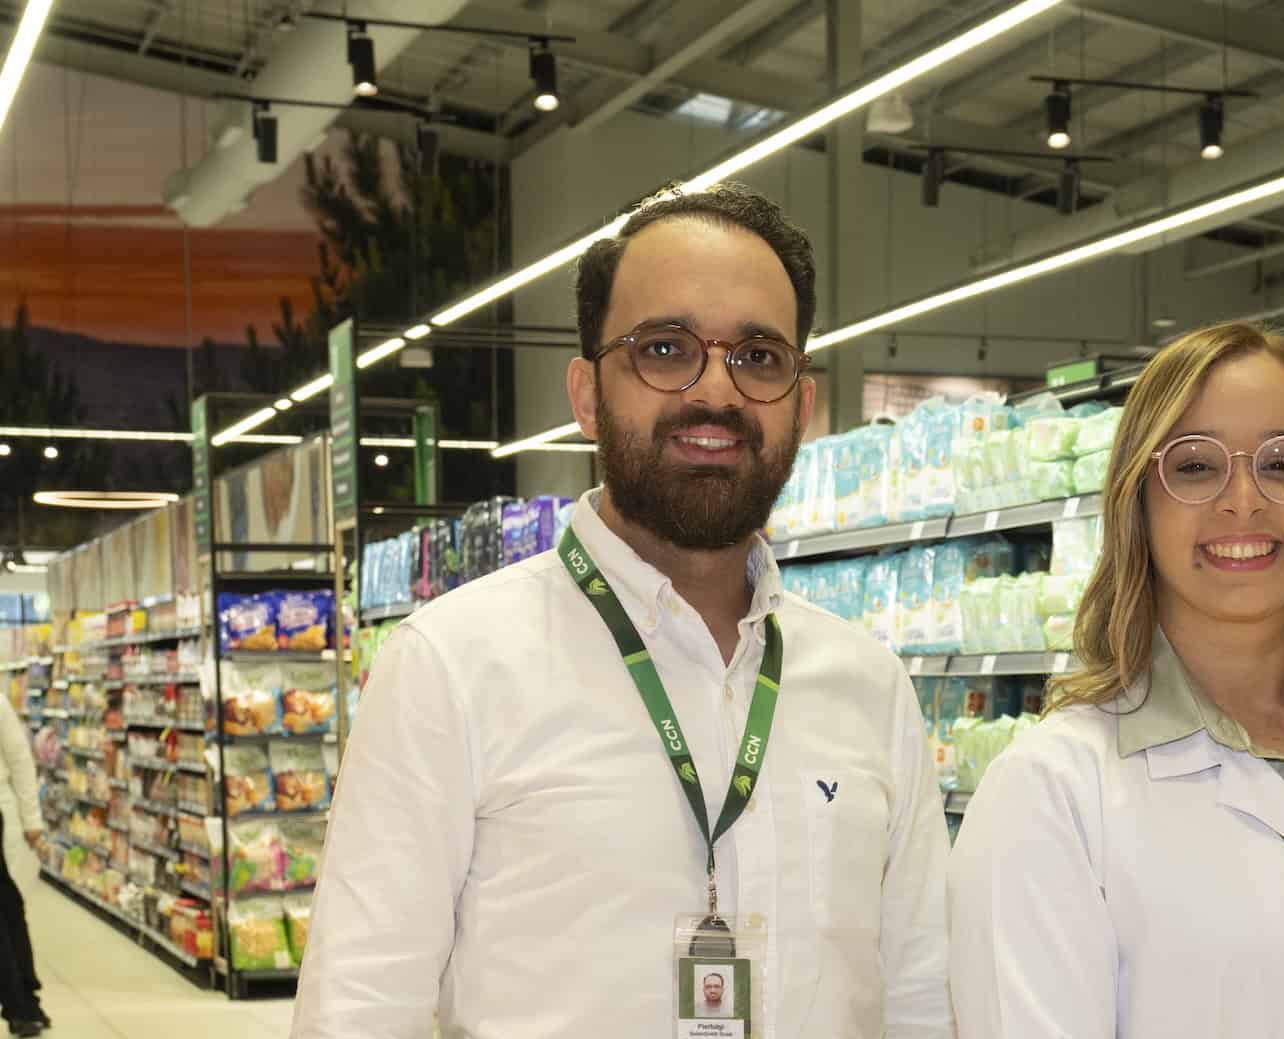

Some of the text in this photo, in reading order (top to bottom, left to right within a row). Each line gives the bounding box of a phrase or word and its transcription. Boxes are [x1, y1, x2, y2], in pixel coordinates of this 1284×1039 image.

[568, 548, 589, 575] CCN
[660, 719, 681, 751] CCN
[743, 735, 761, 764] CCN
